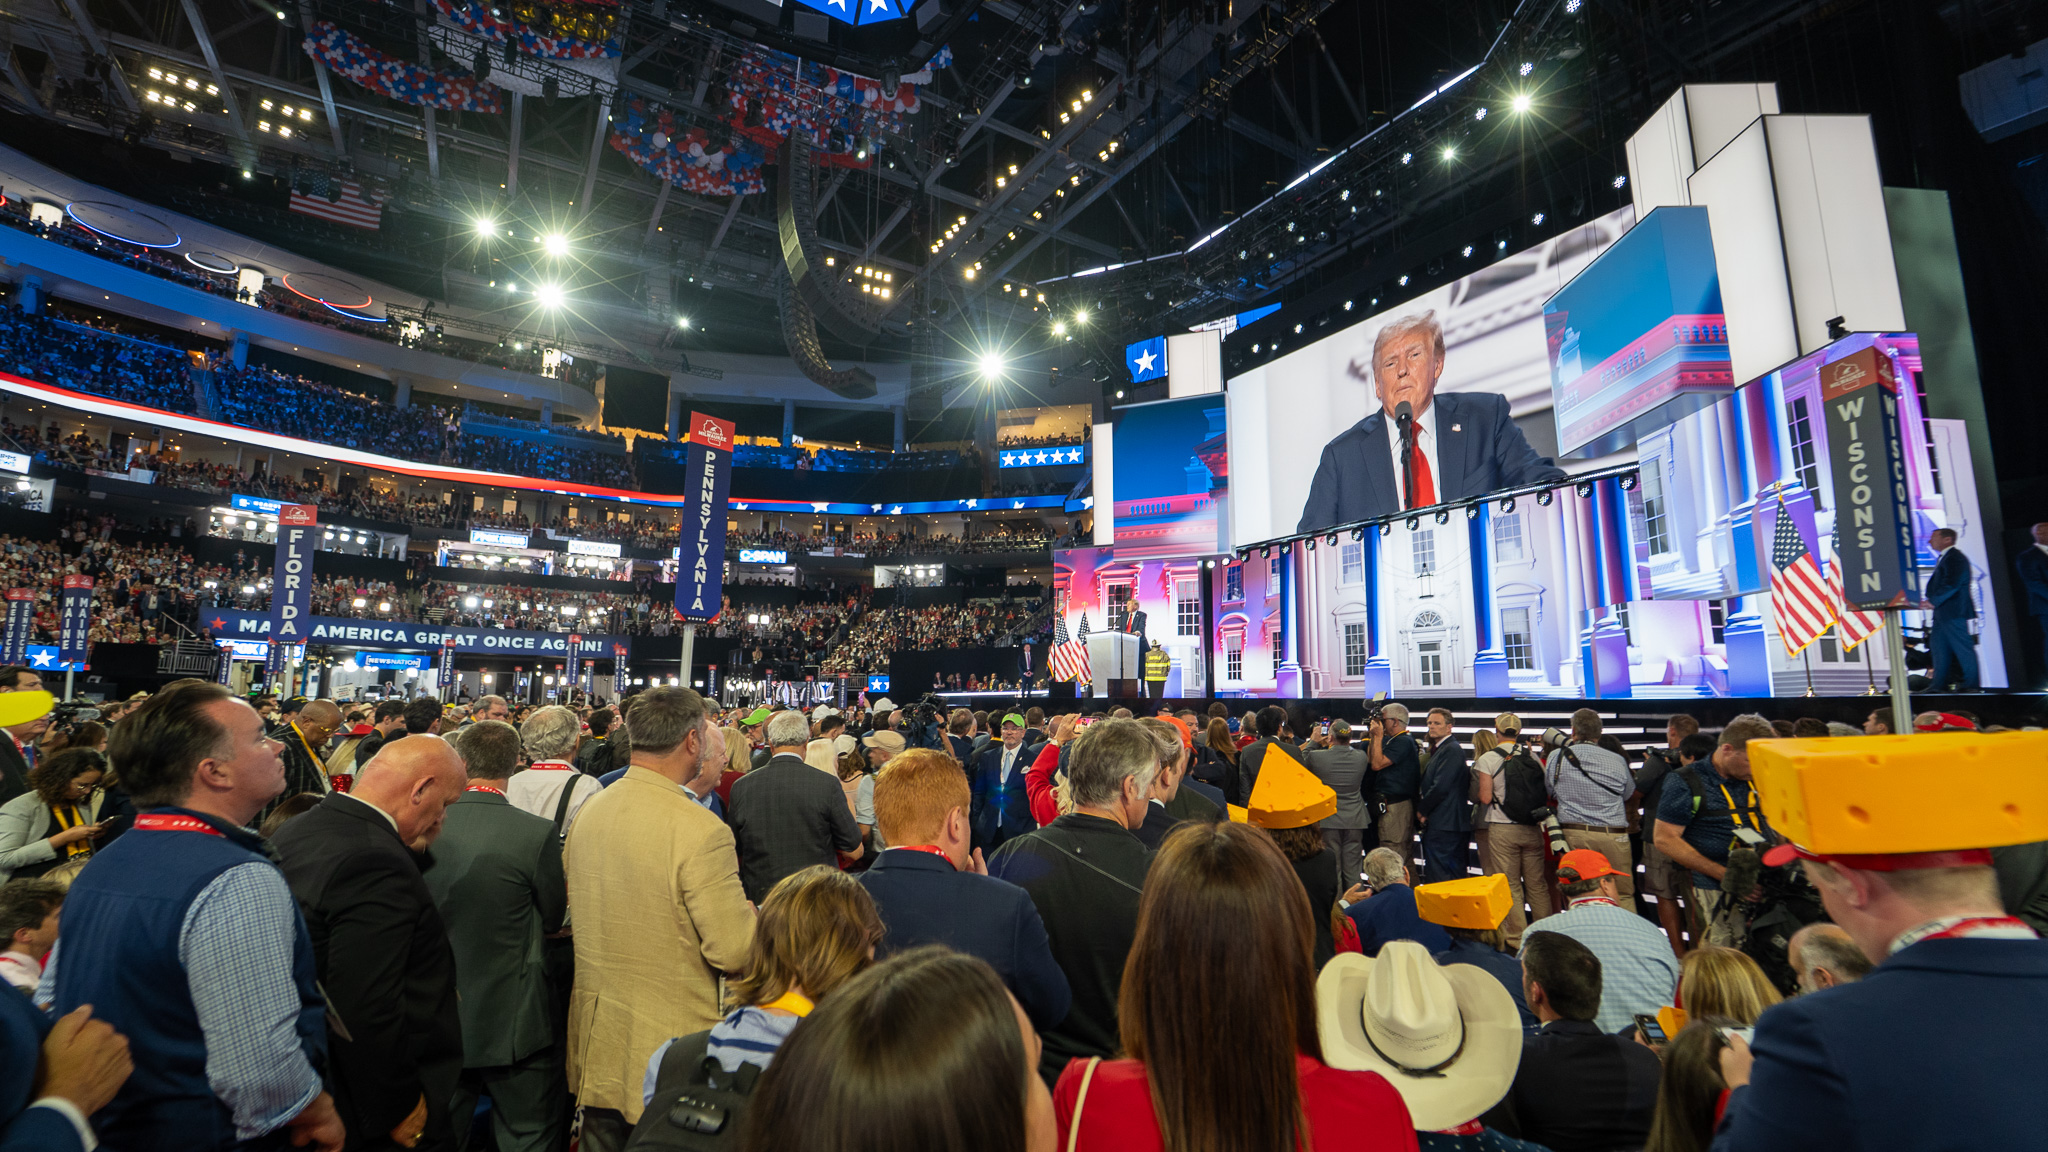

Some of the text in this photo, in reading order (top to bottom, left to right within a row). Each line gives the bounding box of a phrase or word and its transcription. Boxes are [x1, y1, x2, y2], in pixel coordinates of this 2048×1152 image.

[698, 430, 727, 443] MILWAUKEE
[1837, 396, 1882, 593] WISCONSIN
[1883, 394, 1917, 591] WISCONSIN
[571, 543, 618, 553] NEWSMAX
[691, 450, 716, 611] PENNSYLVANIA
[740, 550, 786, 563] C-SPAN
[279, 529, 304, 635] FLORIDA
[4, 601, 18, 661] KENTUCKY
[17, 602, 31, 661] KENTUCKY
[62, 597, 75, 650] MAINE
[76, 597, 89, 650] MAINE
[239, 618, 271, 633] MA
[312, 624, 407, 643] AMERICA
[414, 632, 478, 646] GREAT
[483, 635, 535, 649] ONCE
[443, 648, 454, 683] TEXAS
